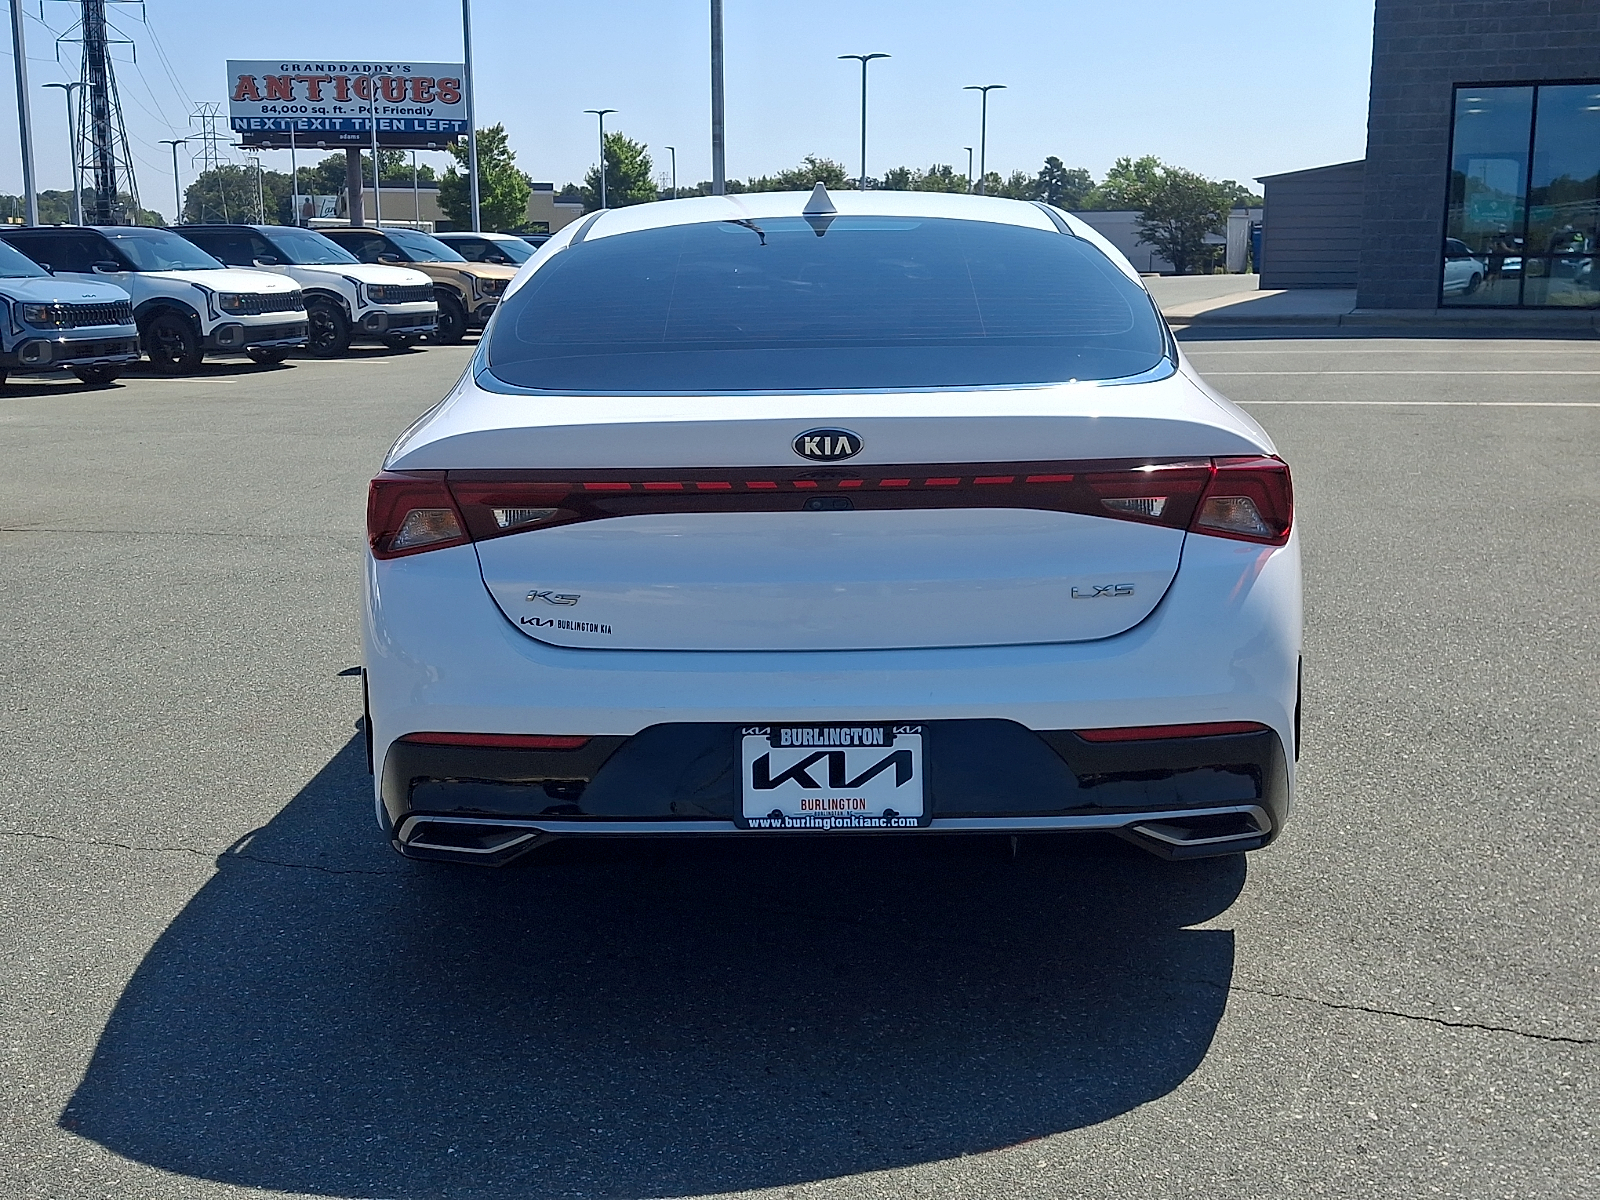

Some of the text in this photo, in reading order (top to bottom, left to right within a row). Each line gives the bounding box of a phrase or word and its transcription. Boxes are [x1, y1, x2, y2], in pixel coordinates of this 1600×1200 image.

[280, 63, 412, 73] GRANDDADDY'S
[231, 74, 463, 105] ANTIQUES
[261, 105, 308, 115] 84,000
[311, 107, 330, 116] sq.
[333, 105, 347, 114] ft.
[382, 106, 434, 117] Friendly
[235, 118, 290, 130] NEXT
[296, 118, 343, 130] EXIT
[413, 119, 463, 132] LEFT
[804, 436, 853, 455] KIA
[525, 590, 581, 606] K5
[557, 619, 599, 633] BURLINGTON
[600, 624, 613, 635] KIA
[780, 727, 884, 746] BURLINGTON
[752, 750, 914, 790] KIA
[800, 798, 867, 811] BURLINGTON
[749, 816, 918, 830] www.burlingtonkianc.com
